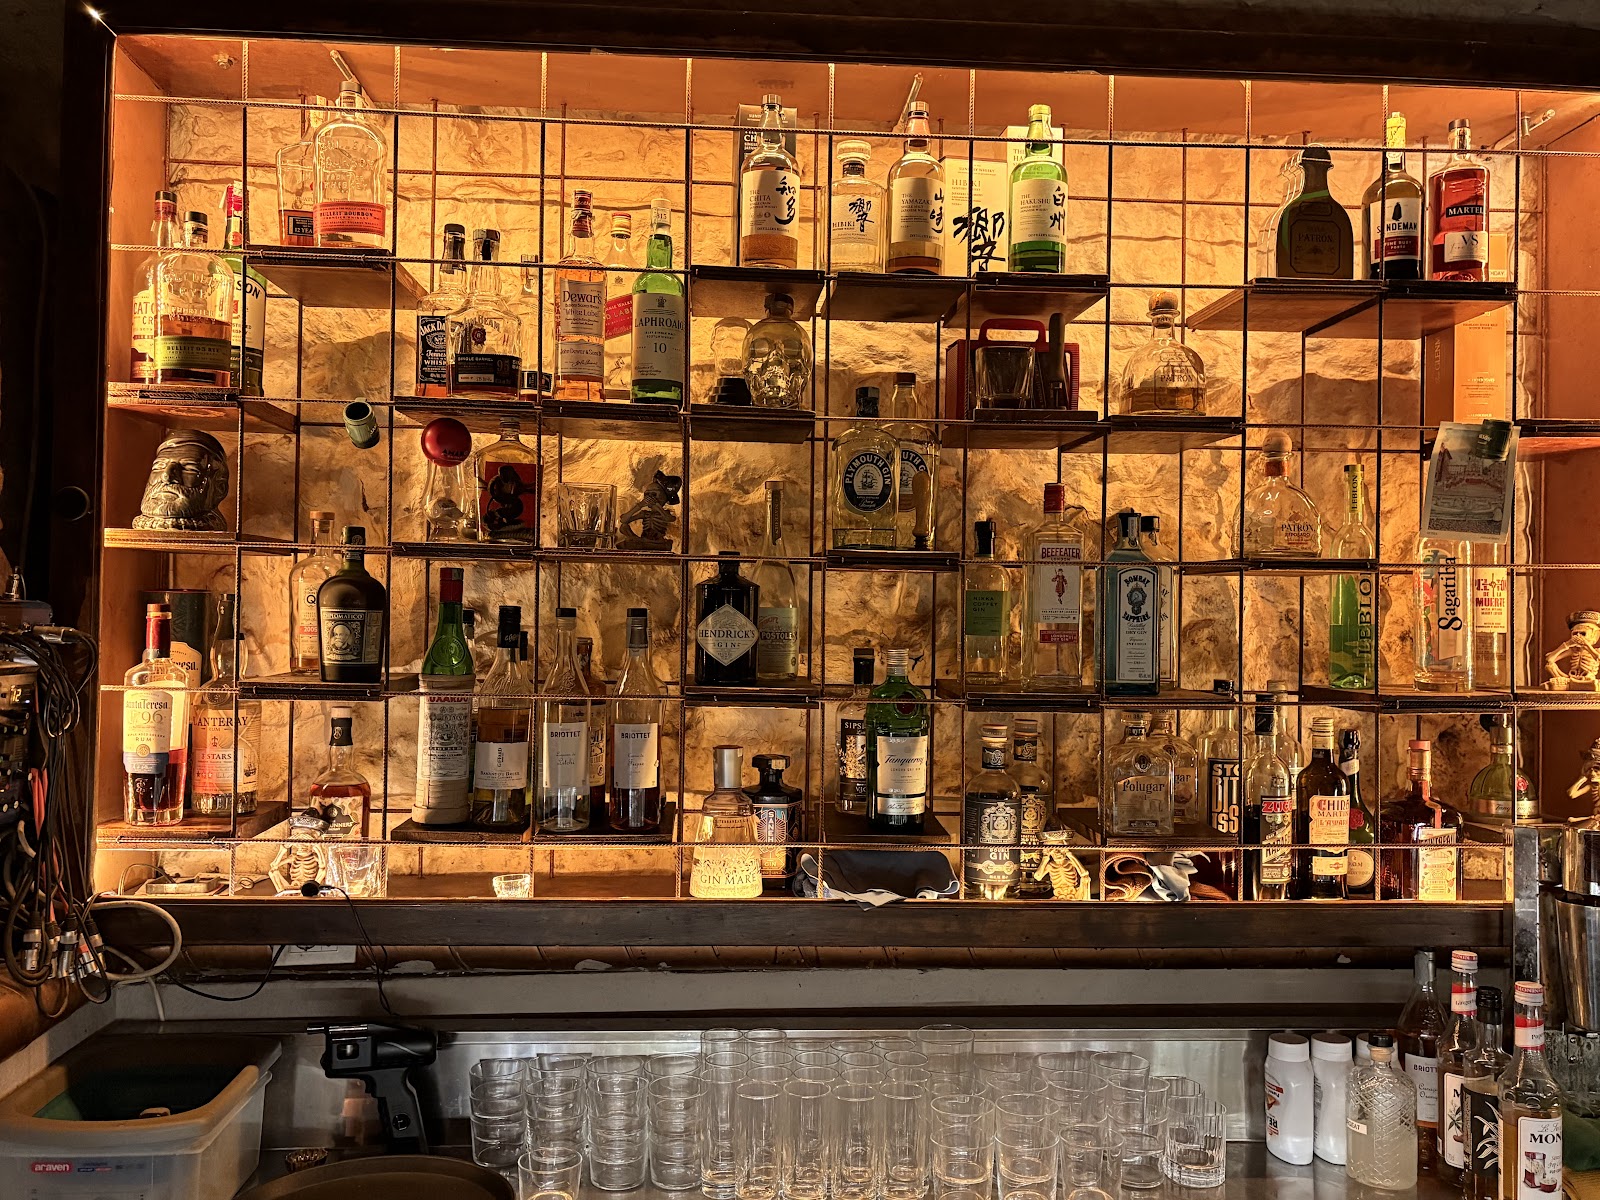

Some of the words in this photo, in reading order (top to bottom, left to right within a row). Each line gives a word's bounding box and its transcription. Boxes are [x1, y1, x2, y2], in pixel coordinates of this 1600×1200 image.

[1377, 222, 1417, 233] SNDEMAN
[563, 290, 602, 304] Dewar's
[653, 342, 667, 353] 10
[845, 455, 885, 484] PLYMOUTH
[882, 467, 891, 485] GIN
[1042, 548, 1080, 559] BEEFEATER
[1124, 575, 1151, 587] BOMBAY
[1438, 557, 1462, 630] Sagatiba
[306, 595, 316, 604] Q
[1359, 573, 1372, 656] LEBLO
[699, 630, 755, 639] HENDRICK'S
[1123, 780, 1165, 794] Polugar
[701, 875, 720, 884] GIN
[725, 873, 756, 884] MARE
[1414, 1064, 1438, 1073] BRIOTT
[1530, 1133, 1562, 1144] MON
[34, 1163, 70, 1172] araven
